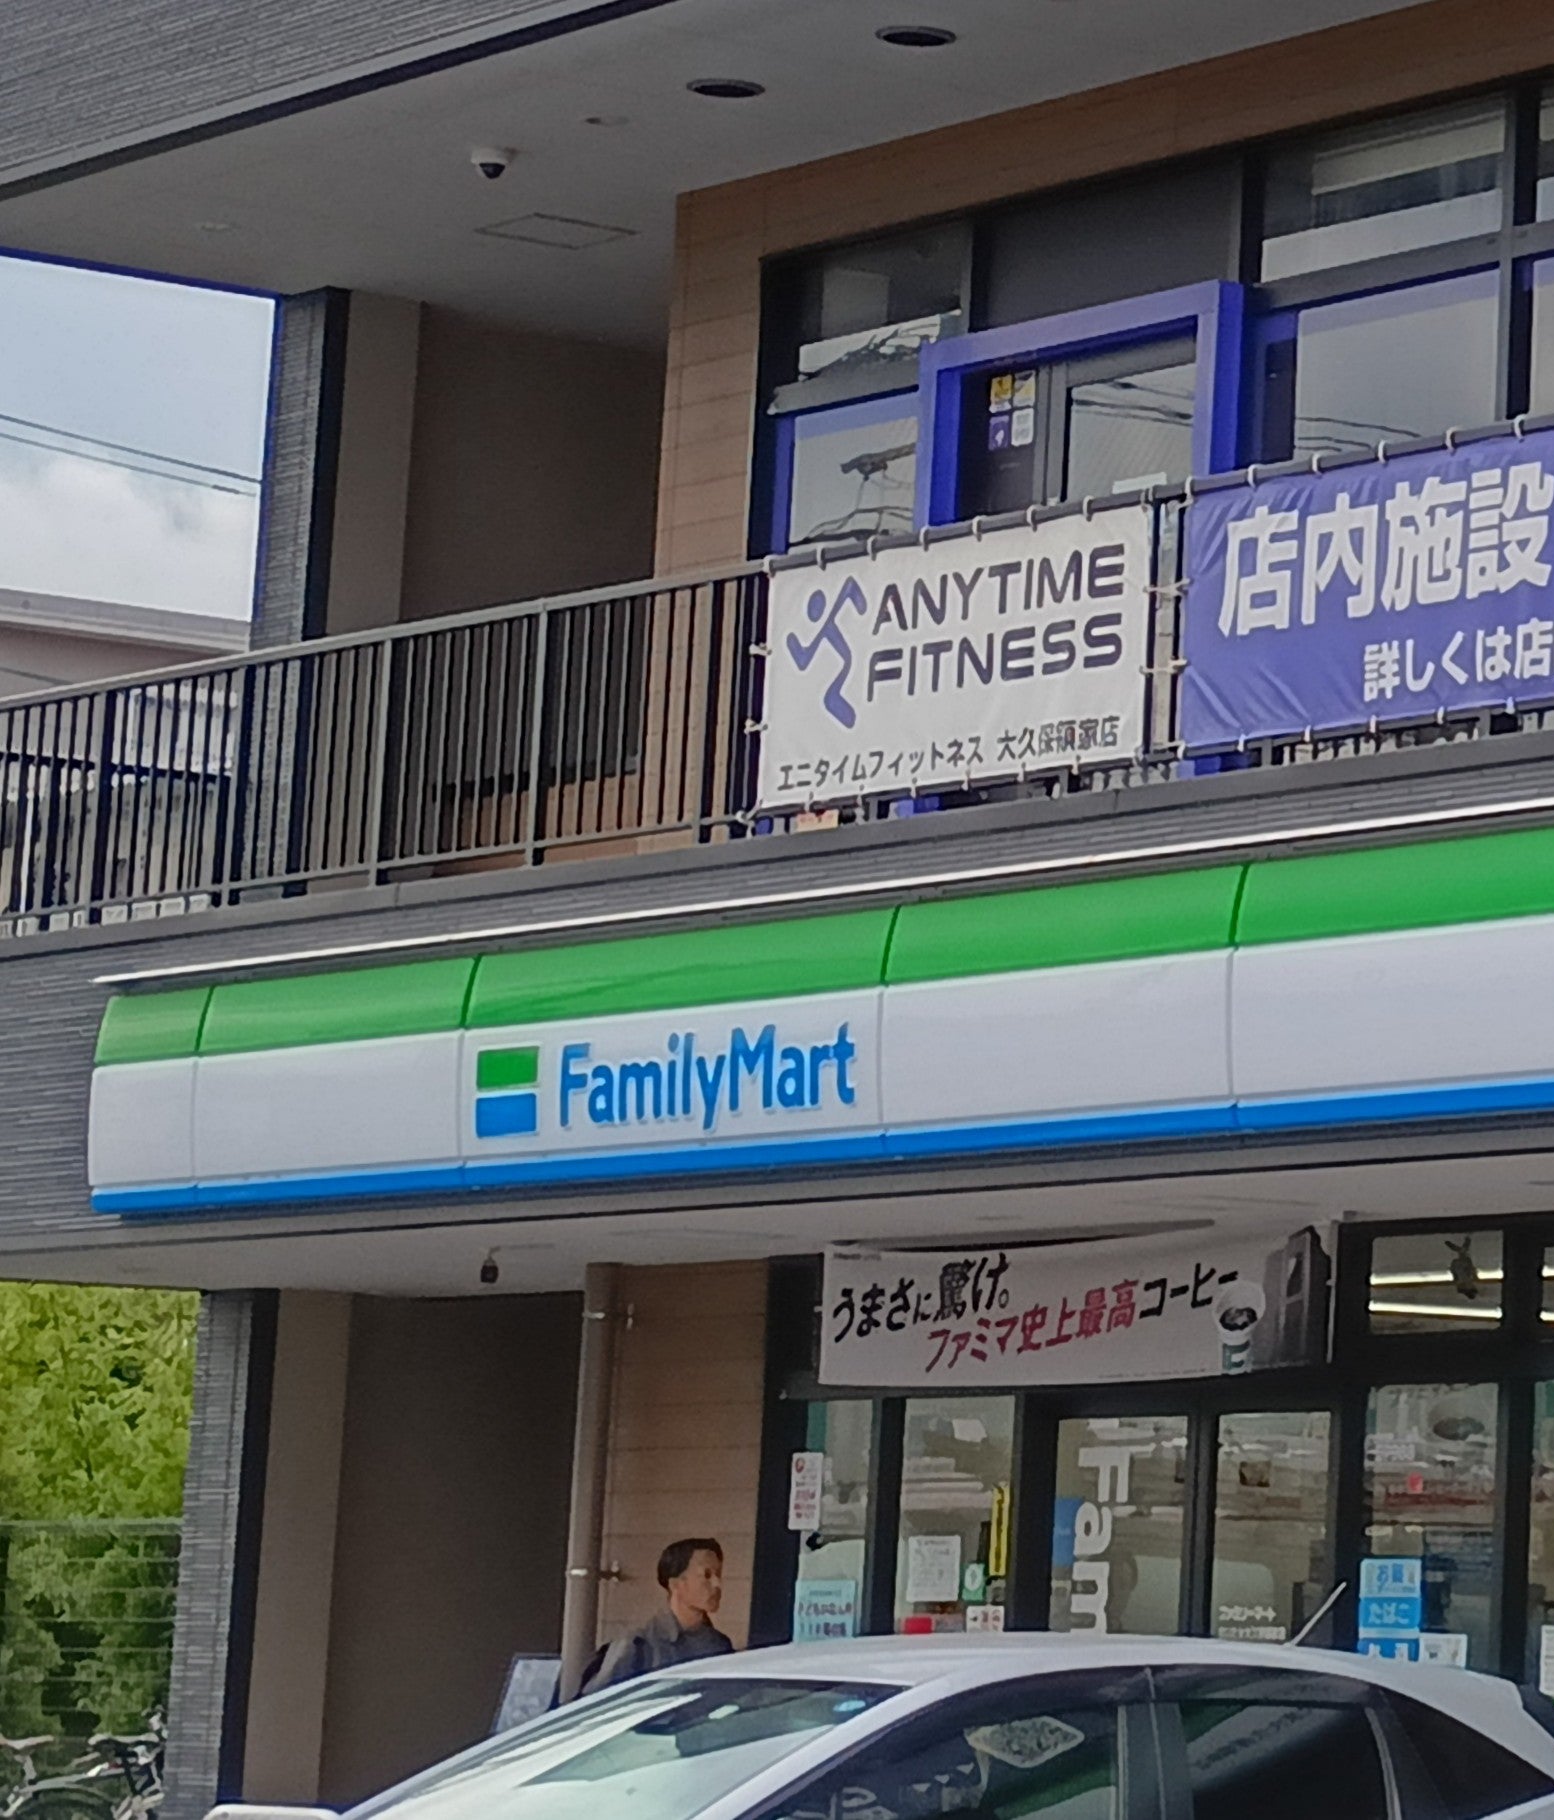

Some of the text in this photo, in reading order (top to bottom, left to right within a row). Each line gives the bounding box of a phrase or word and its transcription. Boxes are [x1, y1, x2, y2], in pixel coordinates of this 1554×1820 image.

[872, 543, 1126, 636] ANYTIME
[866, 612, 1123, 702] FITNESS
[777, 714, 1121, 792] エニタイムフィットネス 大久保領家店
[559, 1021, 856, 1131] FamilyMart
[833, 1252, 1012, 1344] うまさに驚け。
[925, 1262, 1239, 1373] ファミマ史上最高コーヒー
